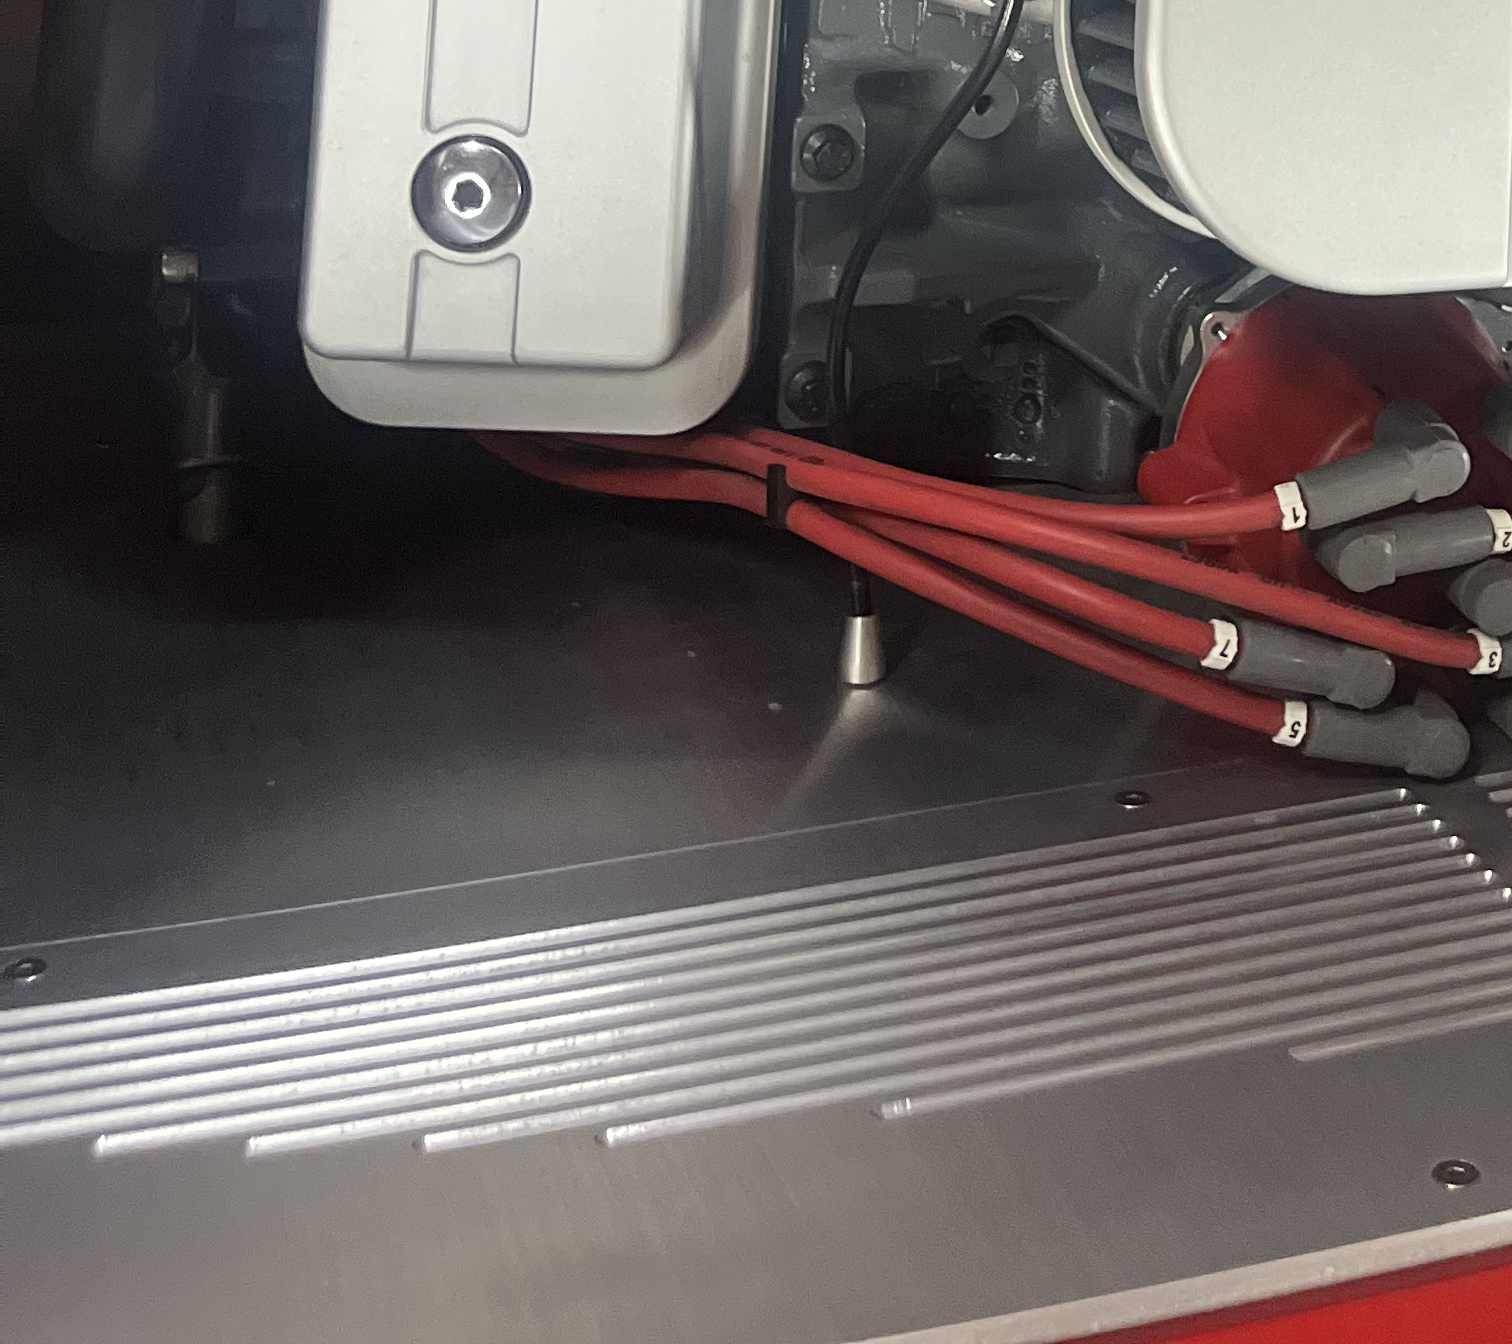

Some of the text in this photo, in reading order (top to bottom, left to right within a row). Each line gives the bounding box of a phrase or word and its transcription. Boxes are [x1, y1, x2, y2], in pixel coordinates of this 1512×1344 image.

[1291, 506, 1300, 524] 1
[1218, 639, 1231, 658] 7
[1488, 650, 1498, 668] 3
[1289, 720, 1302, 739] 5
